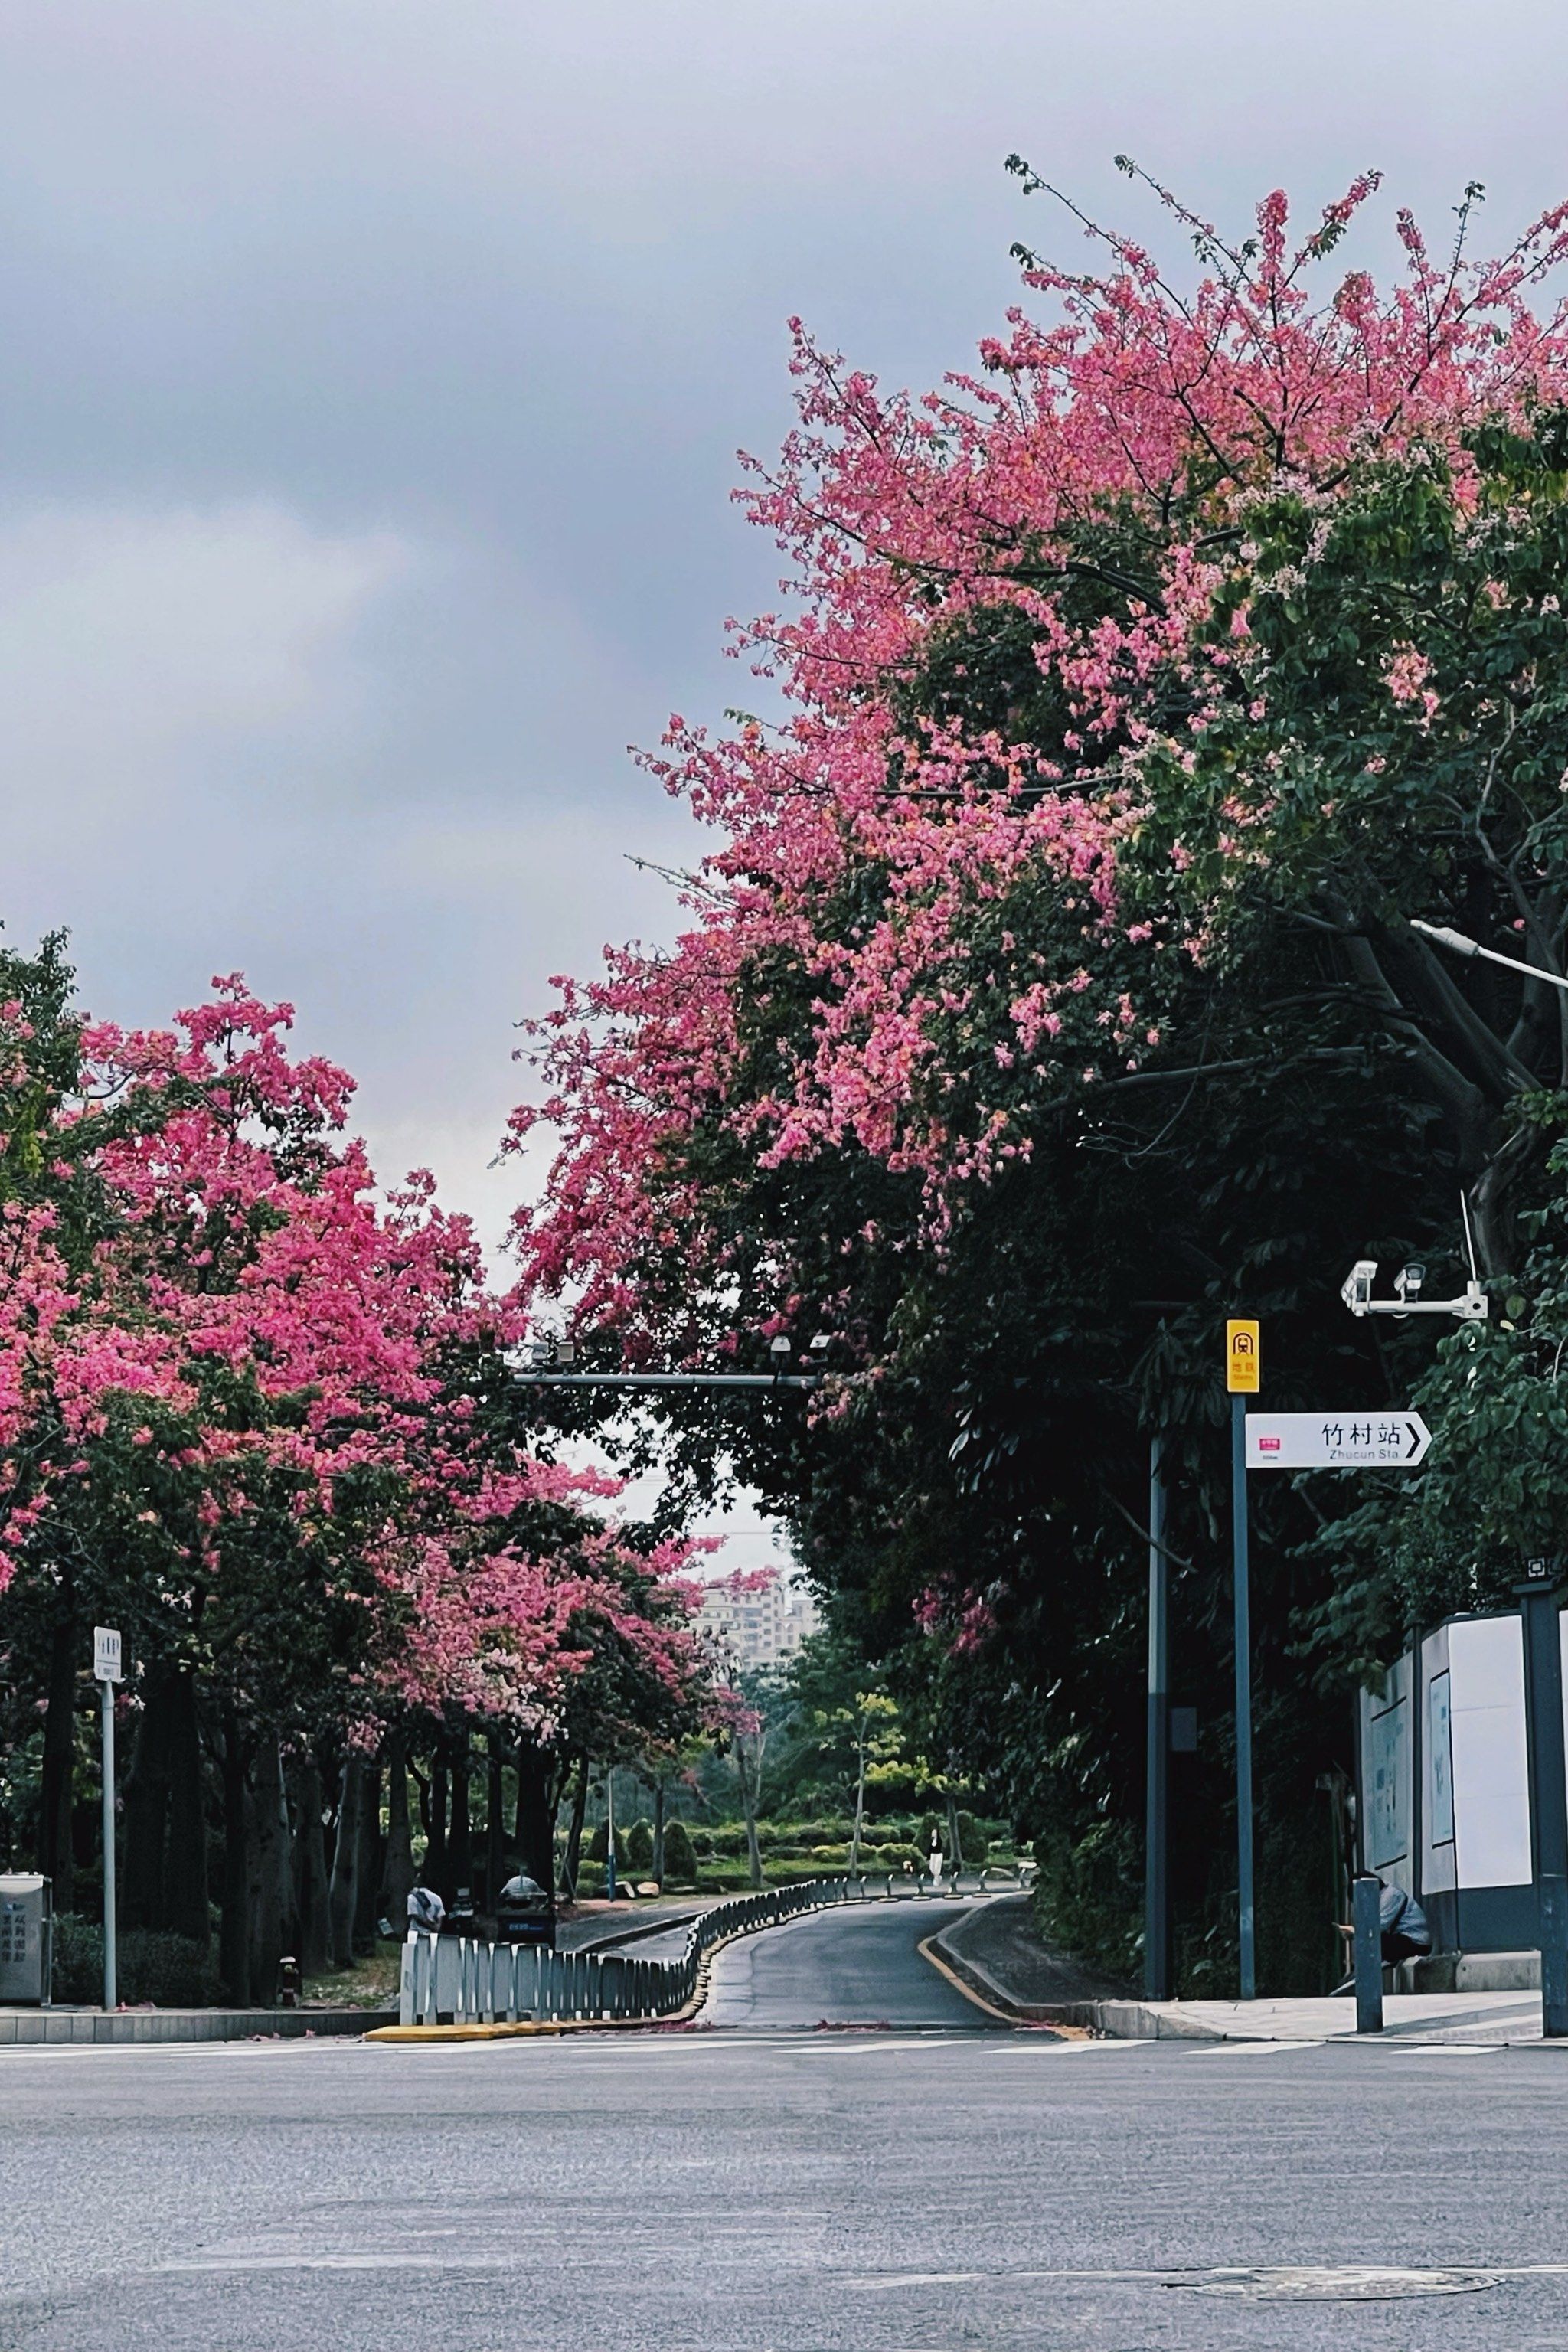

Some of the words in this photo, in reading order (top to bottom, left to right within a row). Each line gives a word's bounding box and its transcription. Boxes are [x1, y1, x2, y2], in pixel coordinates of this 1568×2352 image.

[1321, 1422, 1401, 1446] 竹村站
[1329, 1449, 1375, 1459] Zhucun
